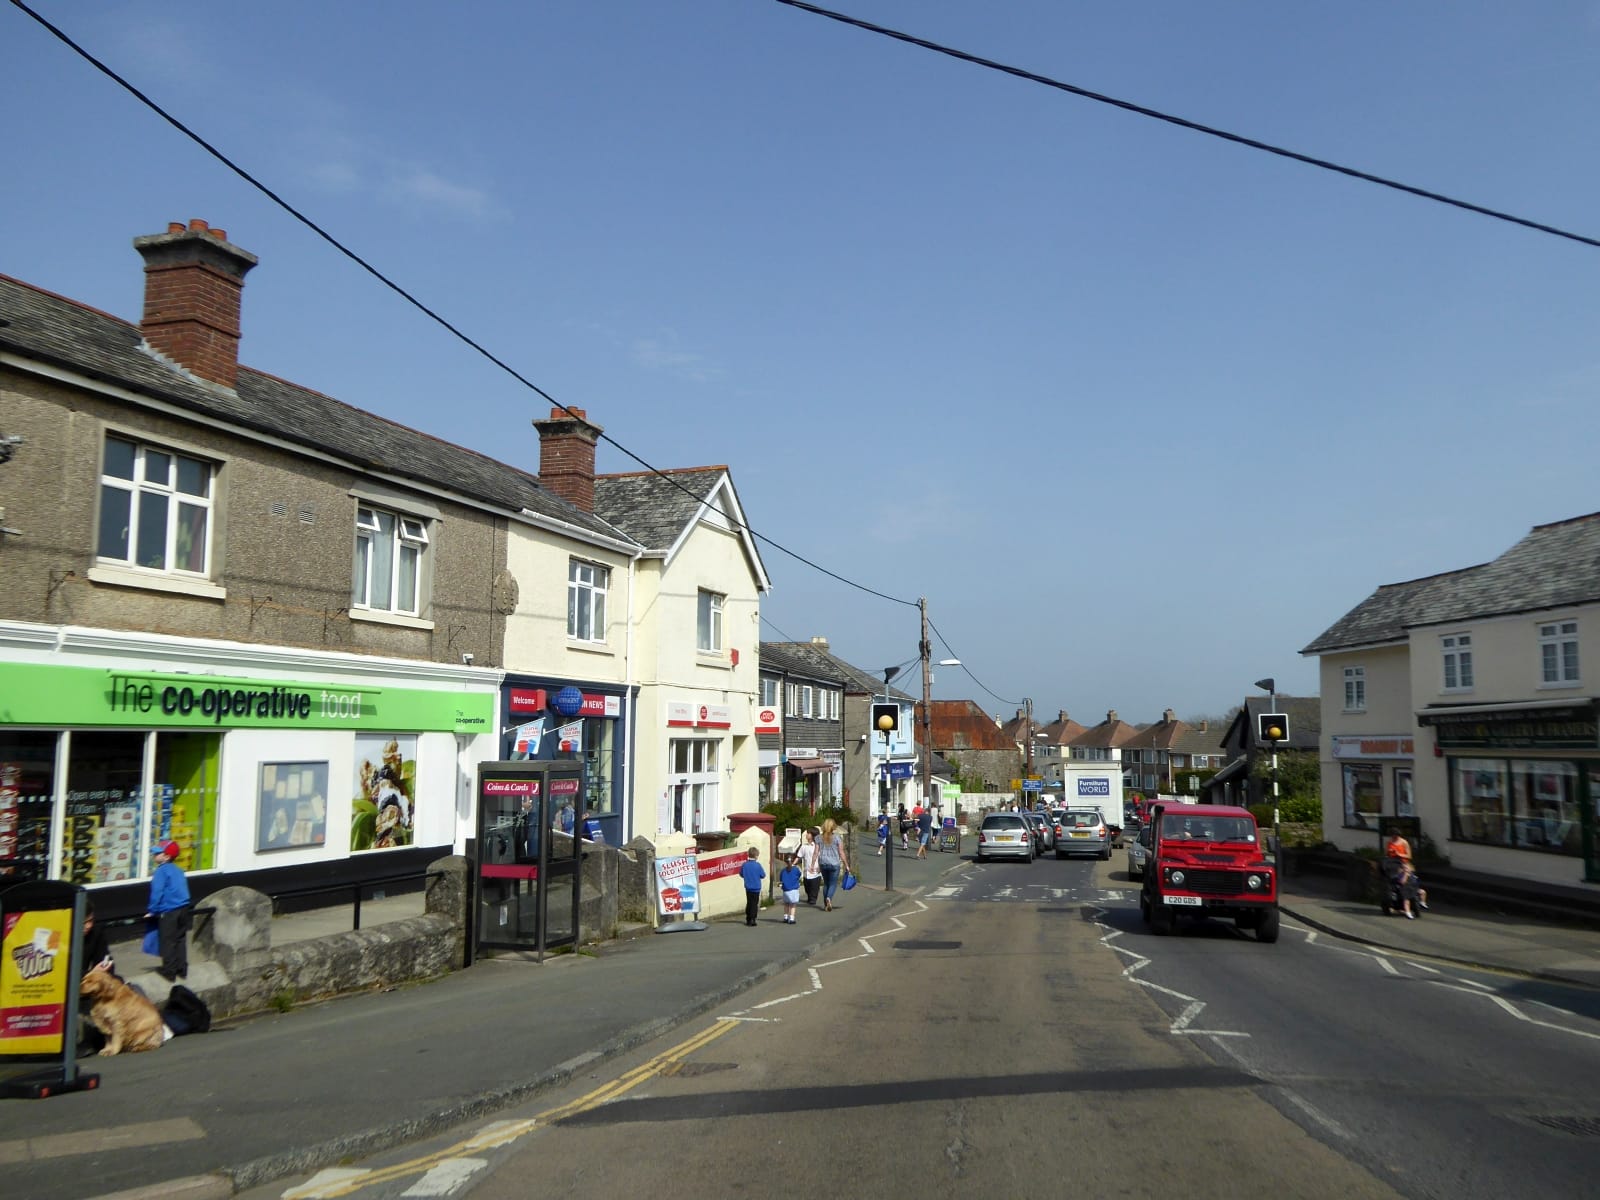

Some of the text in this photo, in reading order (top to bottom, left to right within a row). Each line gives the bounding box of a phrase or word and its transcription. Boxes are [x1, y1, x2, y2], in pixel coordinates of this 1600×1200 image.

[110, 676, 361, 725] The co-operative food
[513, 695, 536, 706] Welcome
[588, 699, 604, 709] NEWS
[487, 782, 529, 792] Coins & Cards
[662, 857, 688, 870] SLUSH
